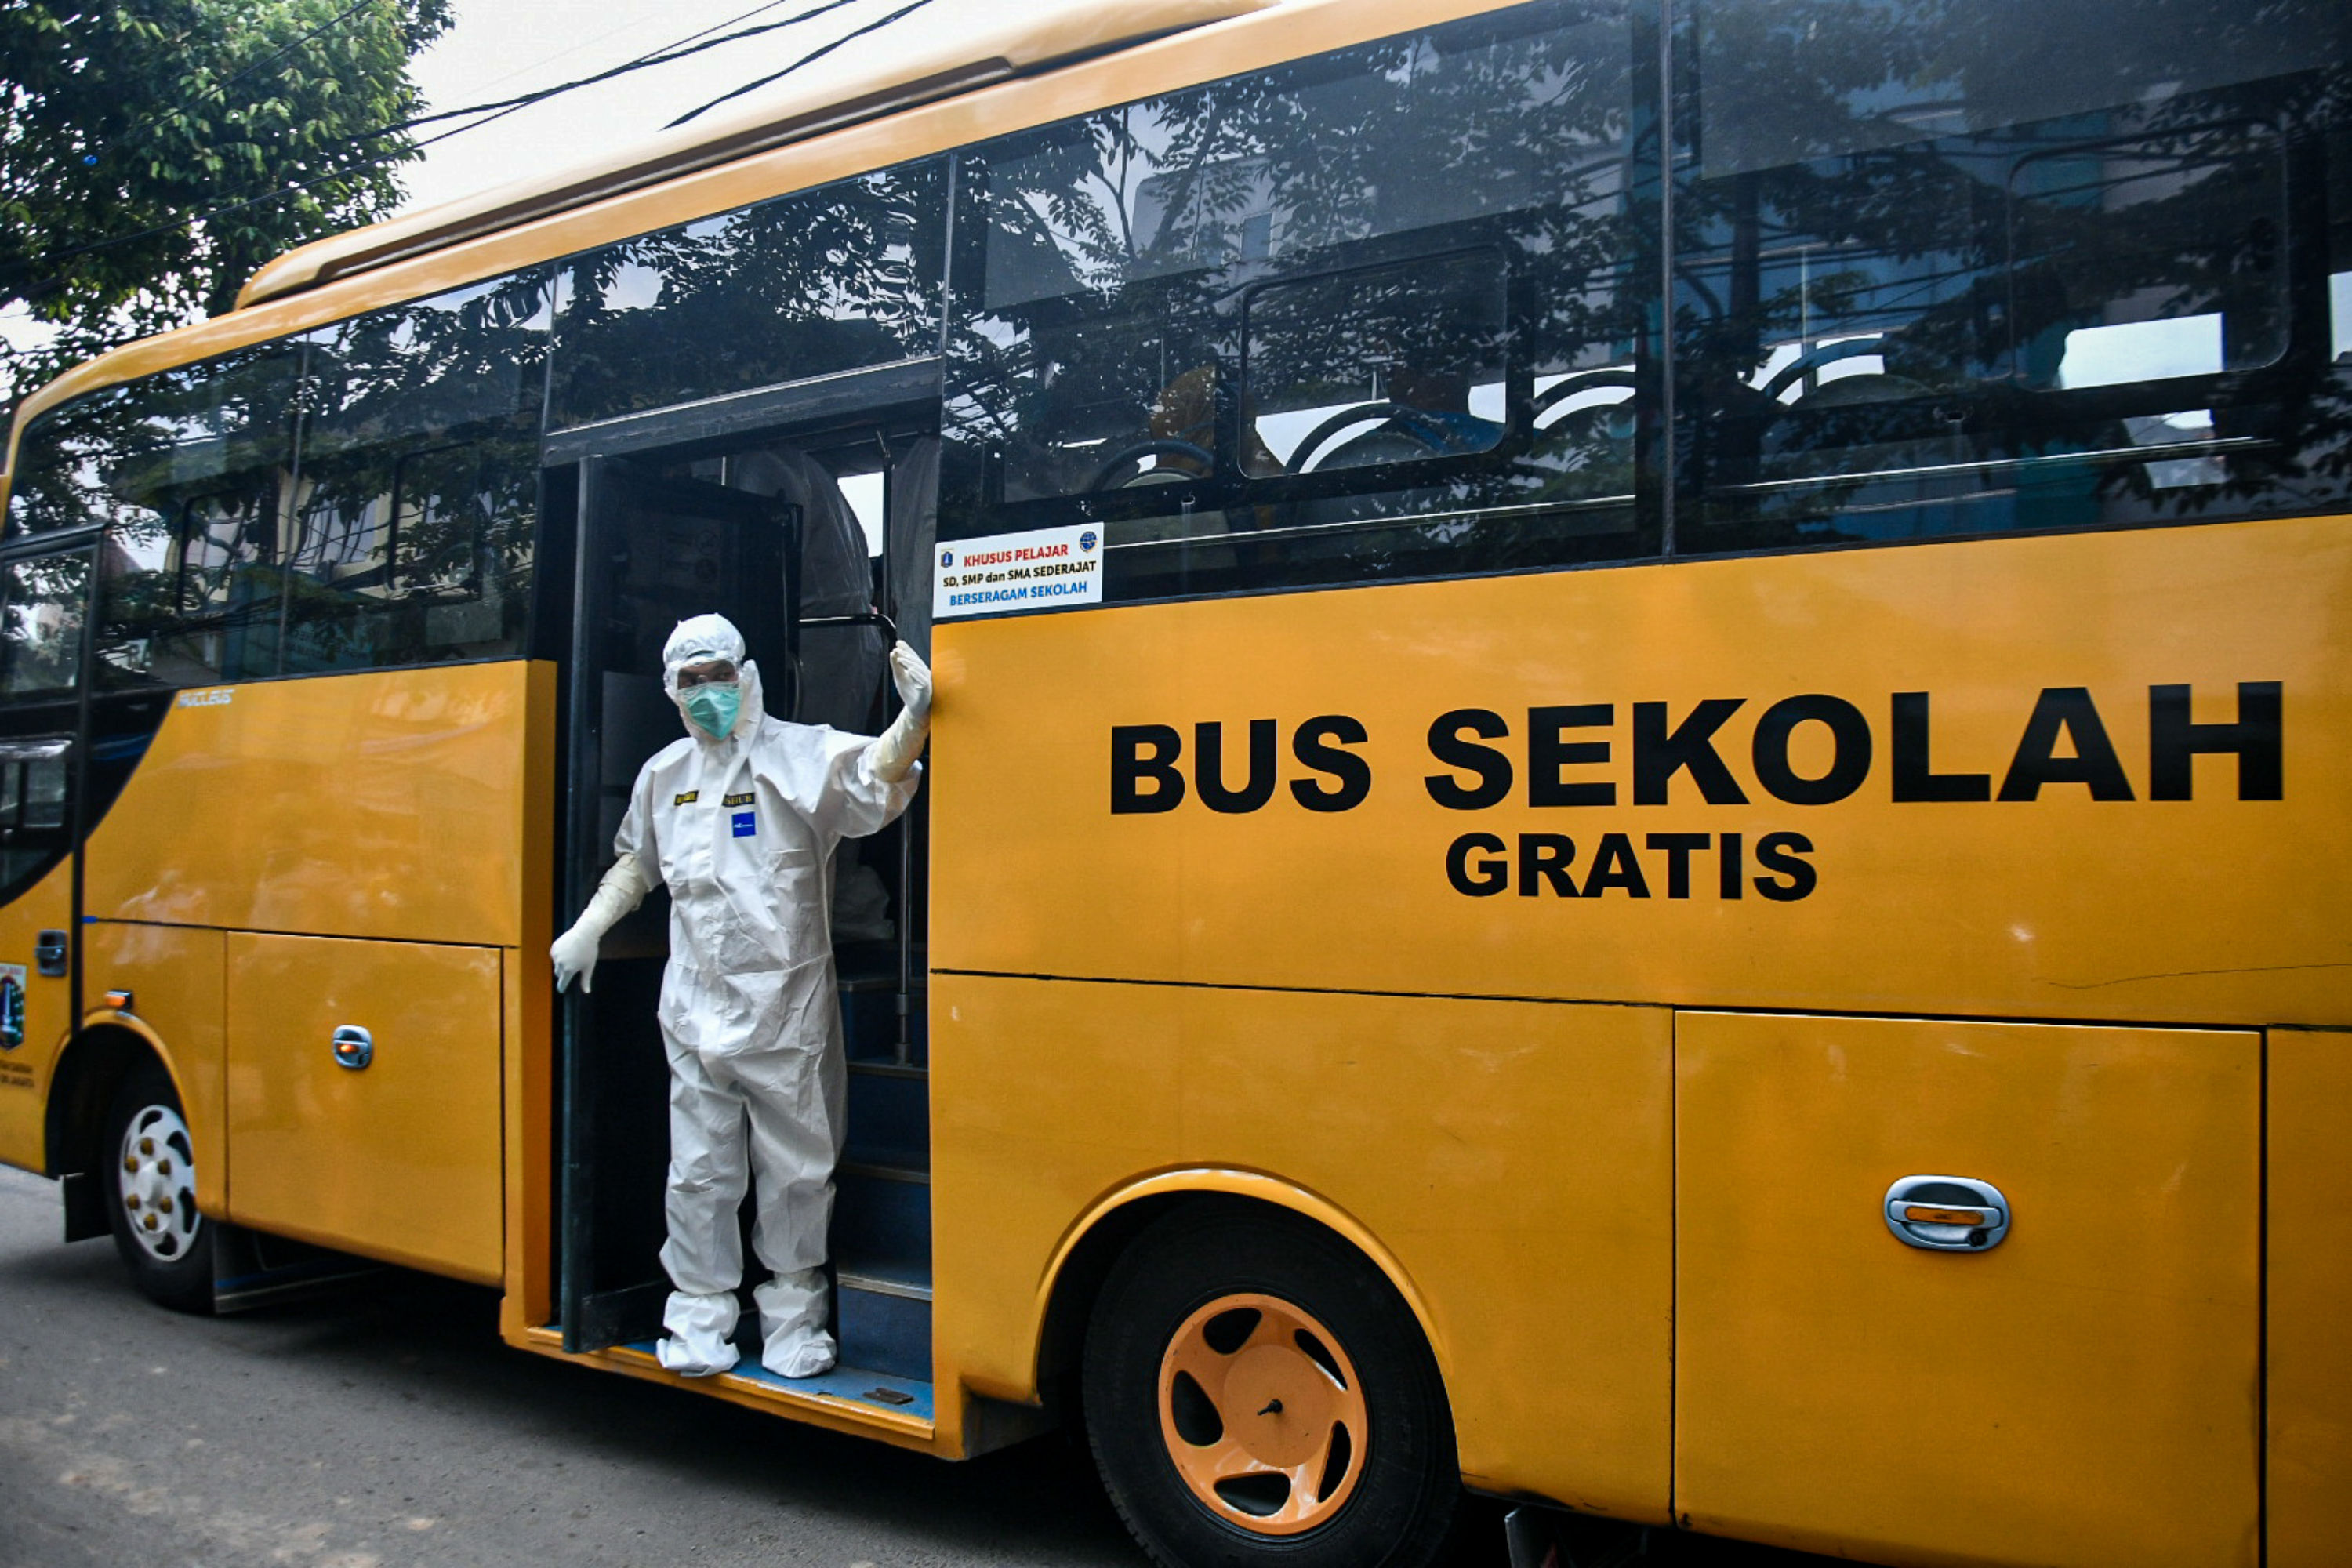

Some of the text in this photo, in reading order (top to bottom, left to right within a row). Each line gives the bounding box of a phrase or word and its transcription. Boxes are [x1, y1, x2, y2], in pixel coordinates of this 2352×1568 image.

[964, 544, 1069, 567] KHUSUS PELAJAR
[943, 560, 1097, 588] SD, SMP dan SMA SEDERAJAT
[949, 581, 1087, 606] BERSERAGAM SEKOLAH
[1110, 681, 2284, 815] BUS SEKOLAH
[1445, 831, 1817, 902] GRATIS
